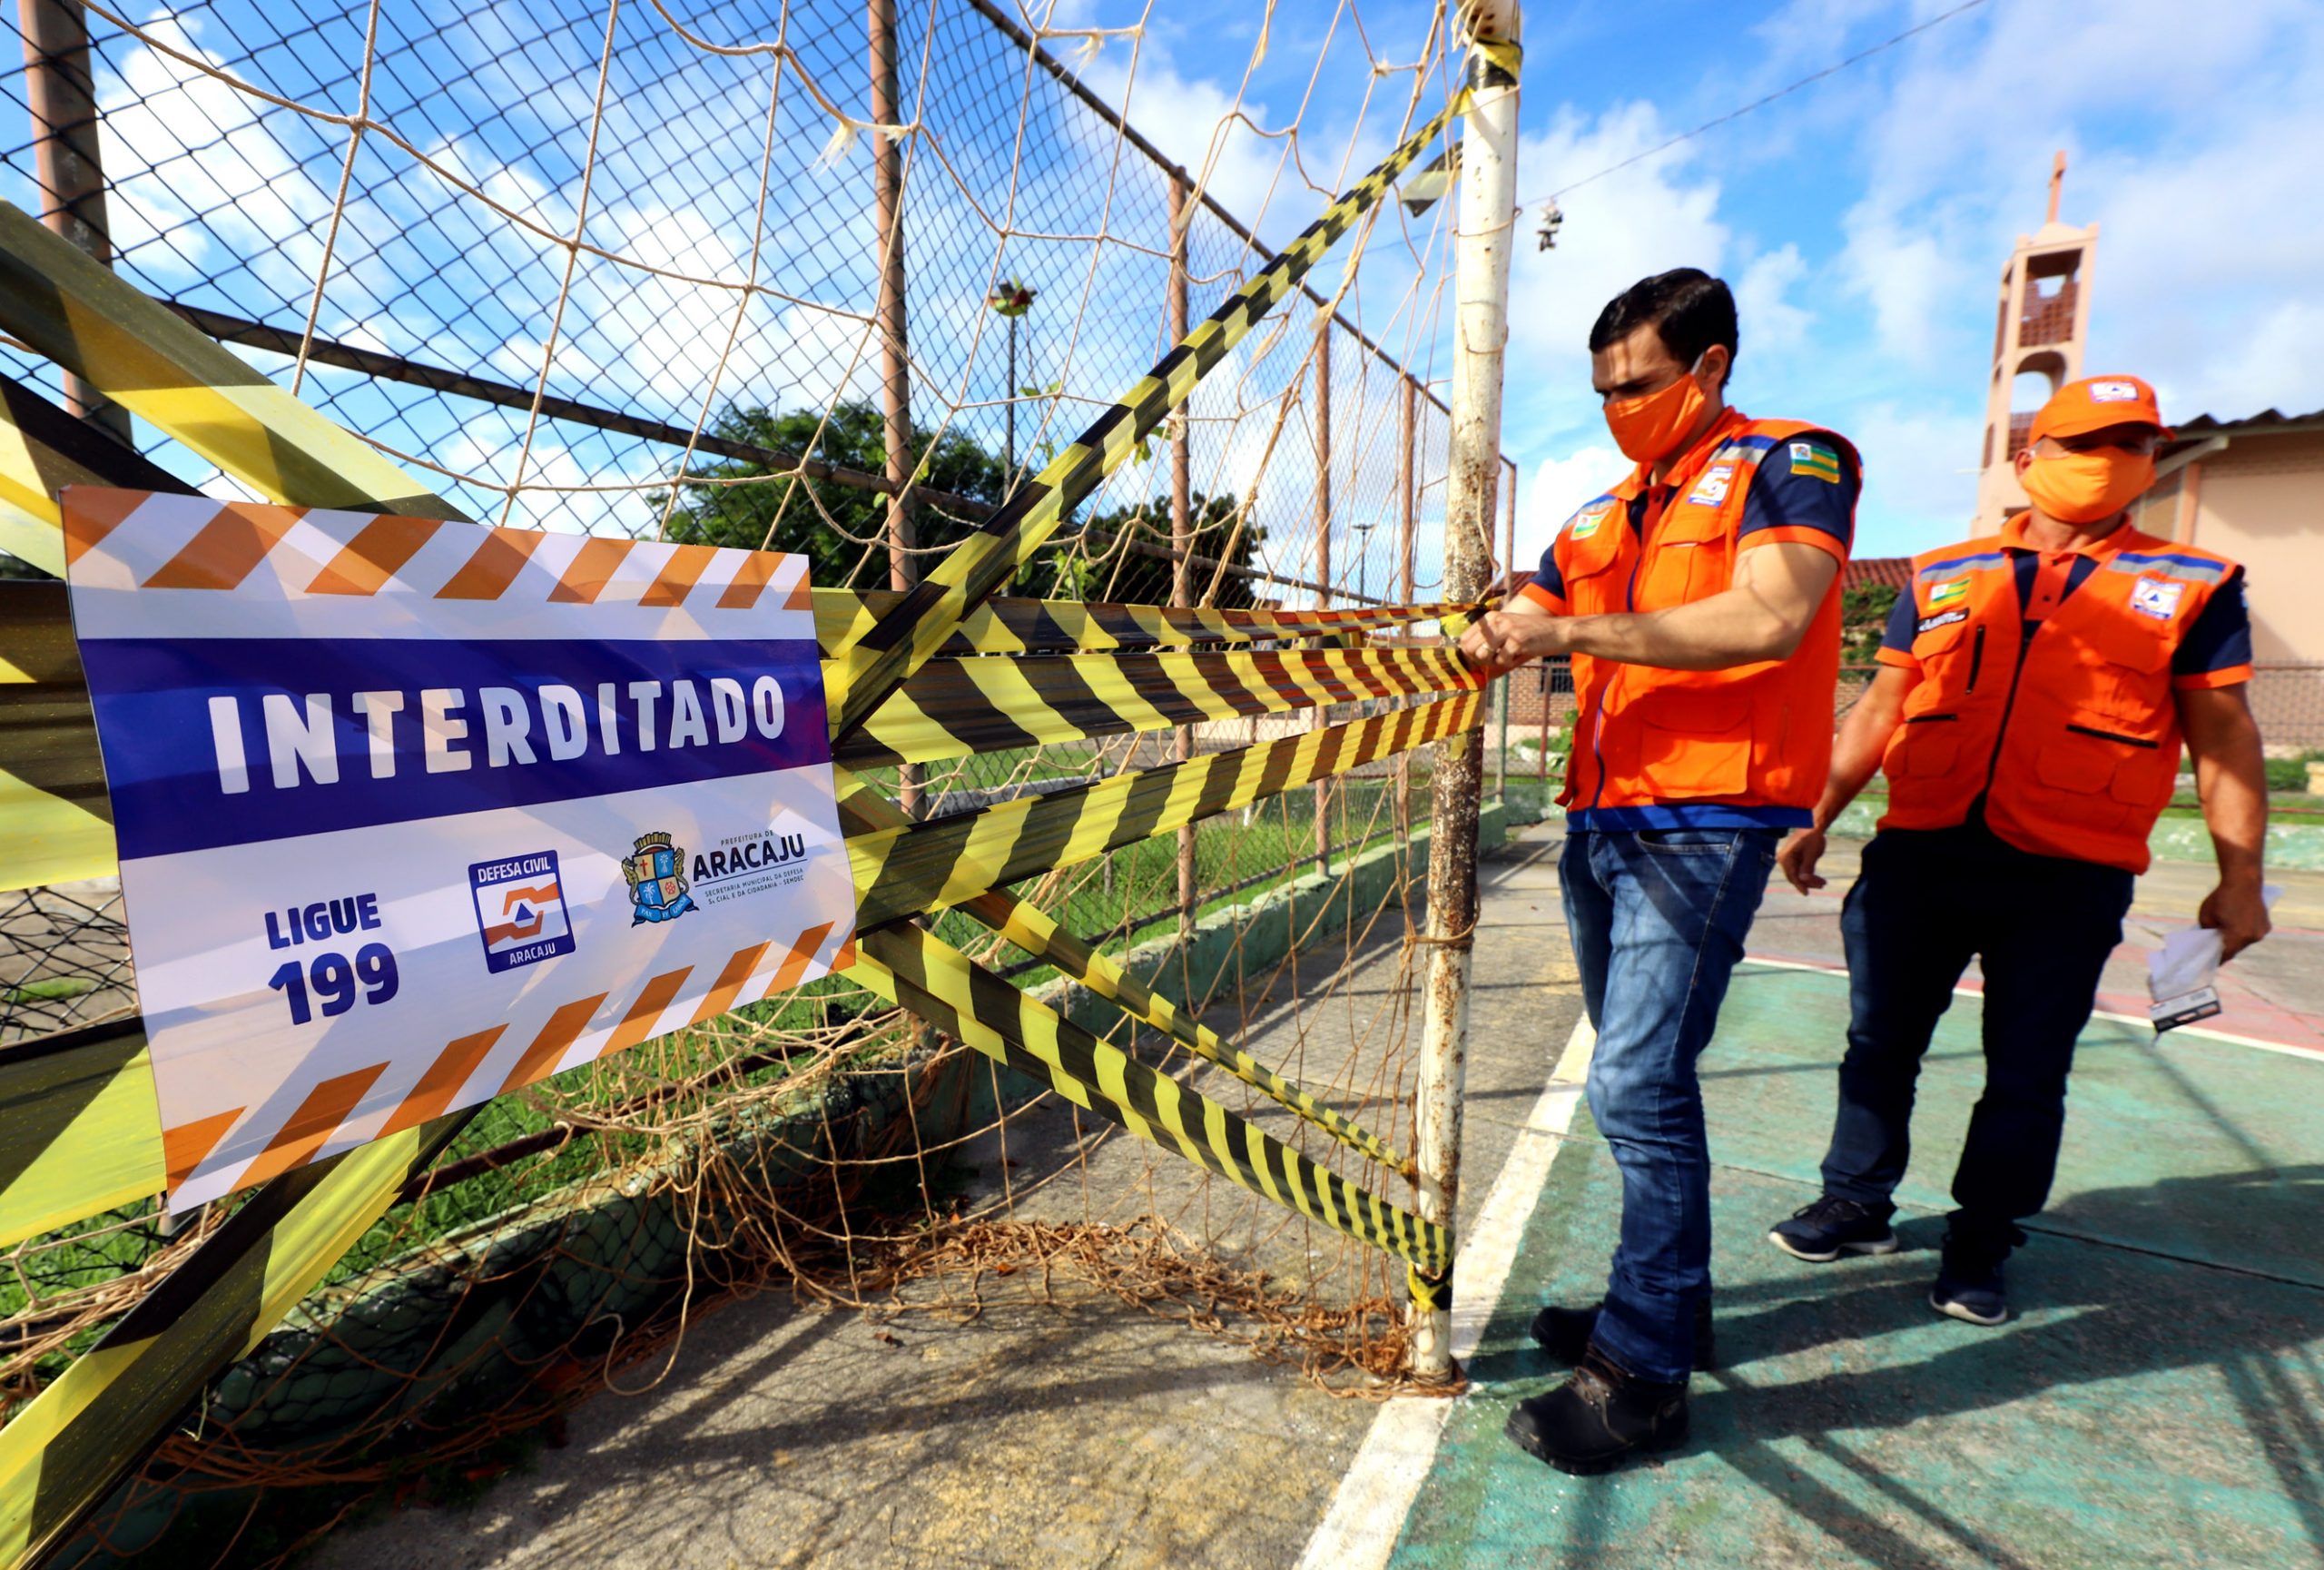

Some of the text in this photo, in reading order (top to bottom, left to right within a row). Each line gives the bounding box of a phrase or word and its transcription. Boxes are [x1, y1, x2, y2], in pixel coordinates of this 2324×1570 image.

[208, 675, 786, 794] INTERDITADO
[721, 829, 773, 846] PREFEITURA DE
[478, 856, 551, 883] DEFESA CIVIL
[693, 834, 805, 882] ARACAJU
[704, 884, 741, 897] SECRETARIA
[742, 875, 773, 890] MUNICIPAL
[783, 867, 803, 878] DEFESA
[747, 882, 777, 894] CIDADANIA
[783, 875, 804, 885] SEMDEC
[264, 892, 381, 950] LIGUE
[509, 943, 556, 965] ARACAJU
[268, 943, 399, 1025] 199
